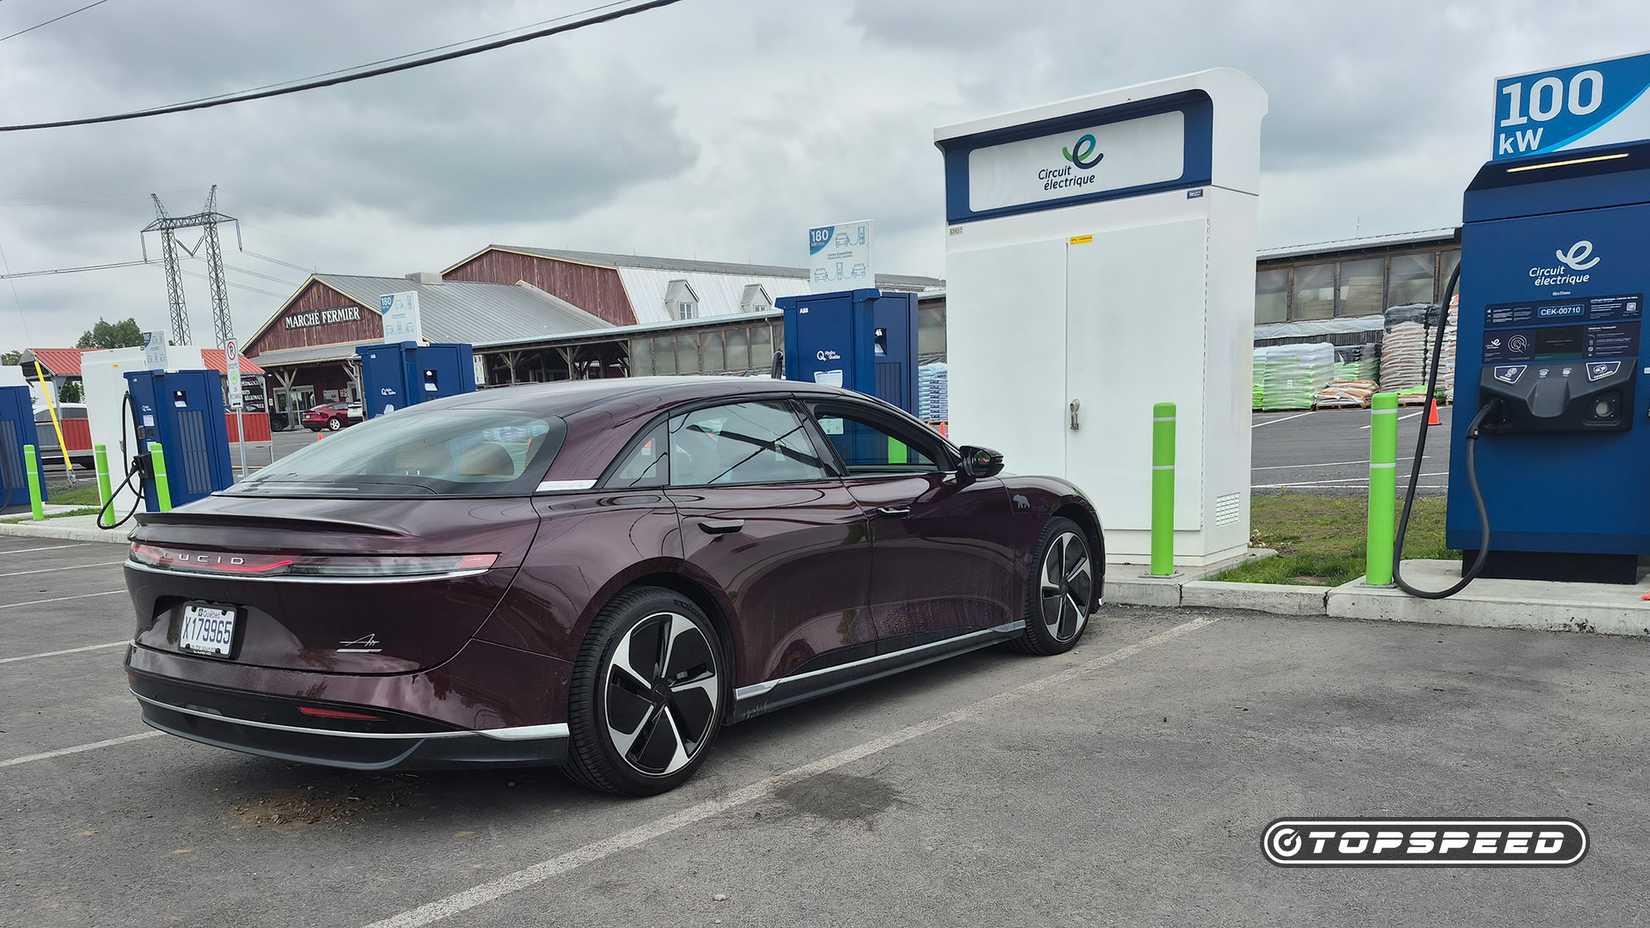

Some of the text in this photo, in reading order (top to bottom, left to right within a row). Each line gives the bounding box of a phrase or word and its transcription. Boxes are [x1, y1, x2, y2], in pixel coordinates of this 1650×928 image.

[1500, 70, 1604, 128] 100
[1499, 128, 1544, 155] kW
[1038, 166, 1073, 181] Circuit
[1044, 173, 1096, 191] électrique
[811, 229, 829, 244] 180
[1529, 265, 1566, 278] Circuit
[1534, 274, 1590, 287] électrique
[285, 306, 360, 329] MARCHÉ FERMIER
[183, 615, 232, 645] X179965
